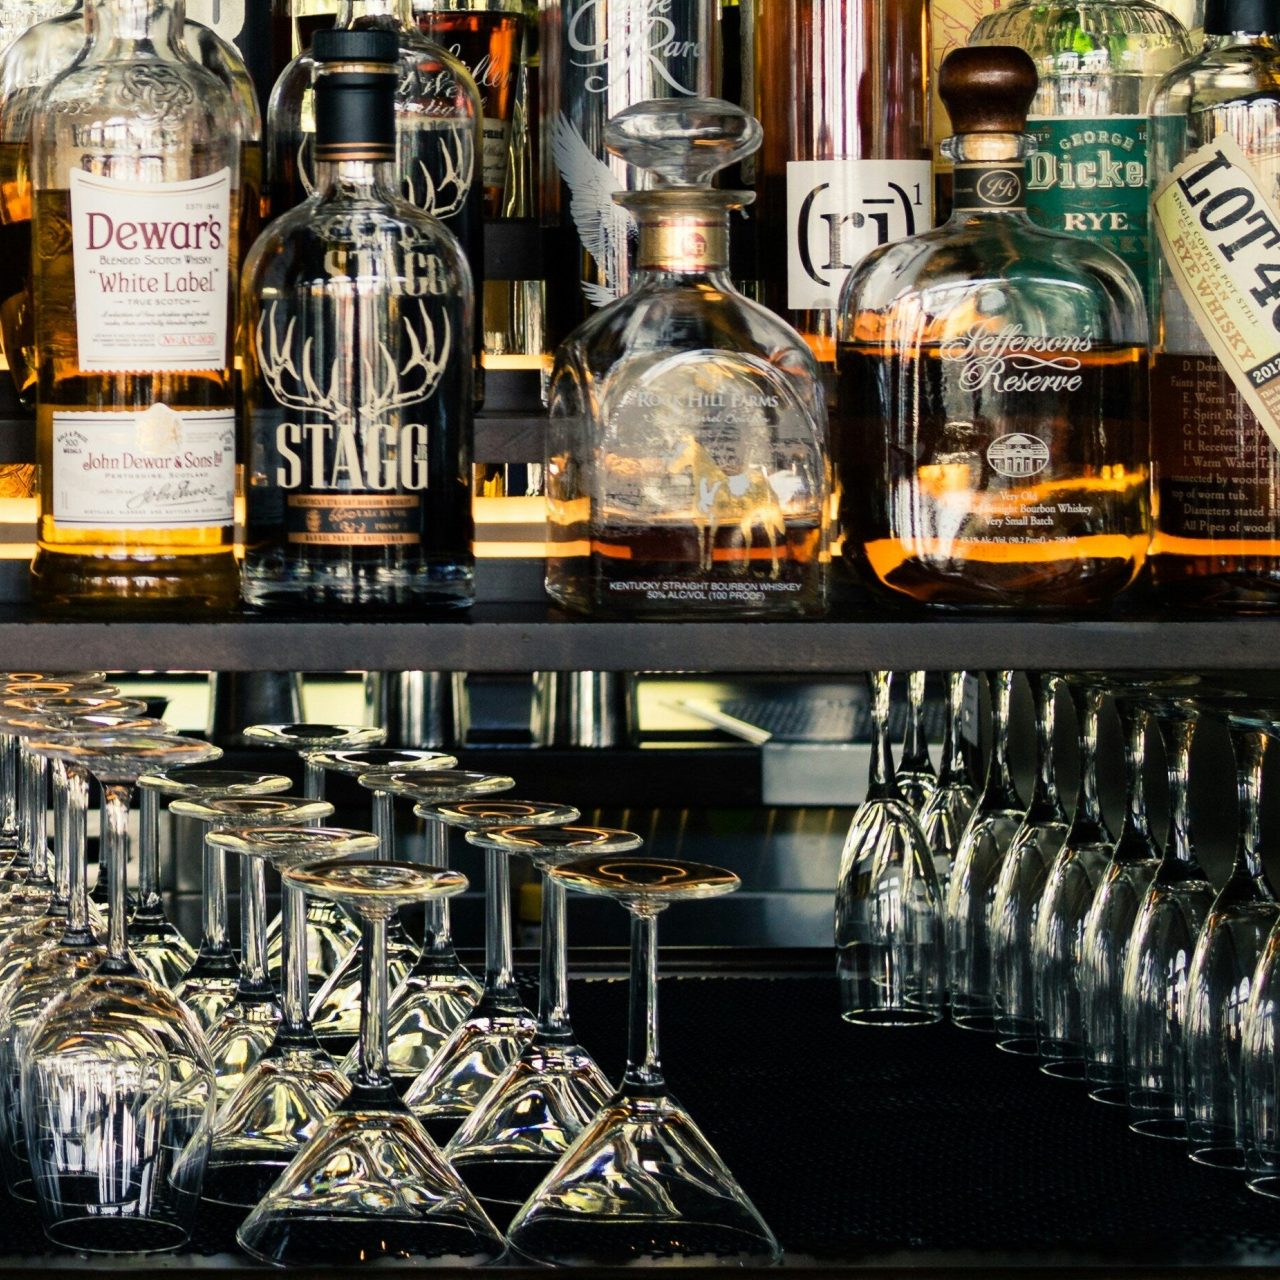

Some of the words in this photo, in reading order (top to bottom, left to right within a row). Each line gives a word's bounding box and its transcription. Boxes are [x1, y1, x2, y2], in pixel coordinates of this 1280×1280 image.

[1059, 131, 1135, 152] GEORGE
[1026, 150, 1149, 190] Dicke
[1177, 150, 1280, 263] LOT
[1064, 212, 1129, 232] RYE
[86, 212, 223, 250] Dewar's
[1172, 192, 1194, 230] SINGLE
[1194, 231, 1221, 272] COPPER
[1220, 274, 1238, 295] POT
[1237, 298, 1259, 327] STILL
[1178, 219, 1229, 301] CANADIAN
[1172, 235, 1200, 278] RYE
[1197, 277, 1256, 362] WHISKY
[939, 320, 1093, 362] Jefferson's
[1183, 361, 1193, 372] D.
[959, 356, 1082, 393] Reserve
[688, 392, 726, 408] HILL
[731, 393, 779, 408] FARMS
[1195, 393, 1225, 403] Worm
[1195, 409, 1221, 423] Spirit
[83, 452, 120, 471] John
[124, 453, 171, 469] Dewar
[174, 457, 182, 469] &
[184, 452, 213, 469] Sons
[276, 423, 430, 491] STAGG
[1193, 456, 1221, 468] Warm
[1216, 473, 1228, 488] by
[1000, 491, 1019, 501] Very
[1021, 491, 1038, 501] Old
[1197, 491, 1225, 500] worm
[1228, 490, 1249, 500] tub.
[1020, 504, 1056, 513] Bourbon
[1058, 504, 1093, 516] Whiskey
[1184, 504, 1231, 516] Diameters
[1234, 506, 1265, 517] stated
[984, 517, 1002, 528] Very
[1006, 516, 1028, 526] Small
[1030, 516, 1054, 526] Batch
[1184, 520, 1197, 531] All
[1200, 520, 1226, 535] Pipes
[1229, 521, 1241, 533] of
[610, 582, 661, 591] KENTUCKY
[663, 583, 709, 591] STRAIGHT
[711, 583, 760, 591] BOURBON
[760, 583, 802, 592] WHISKEY
[647, 592, 666, 600] 50%
[668, 592, 707, 600] ALC/VOL
[708, 592, 727, 601] (100
[729, 592, 765, 601] PROOF)
